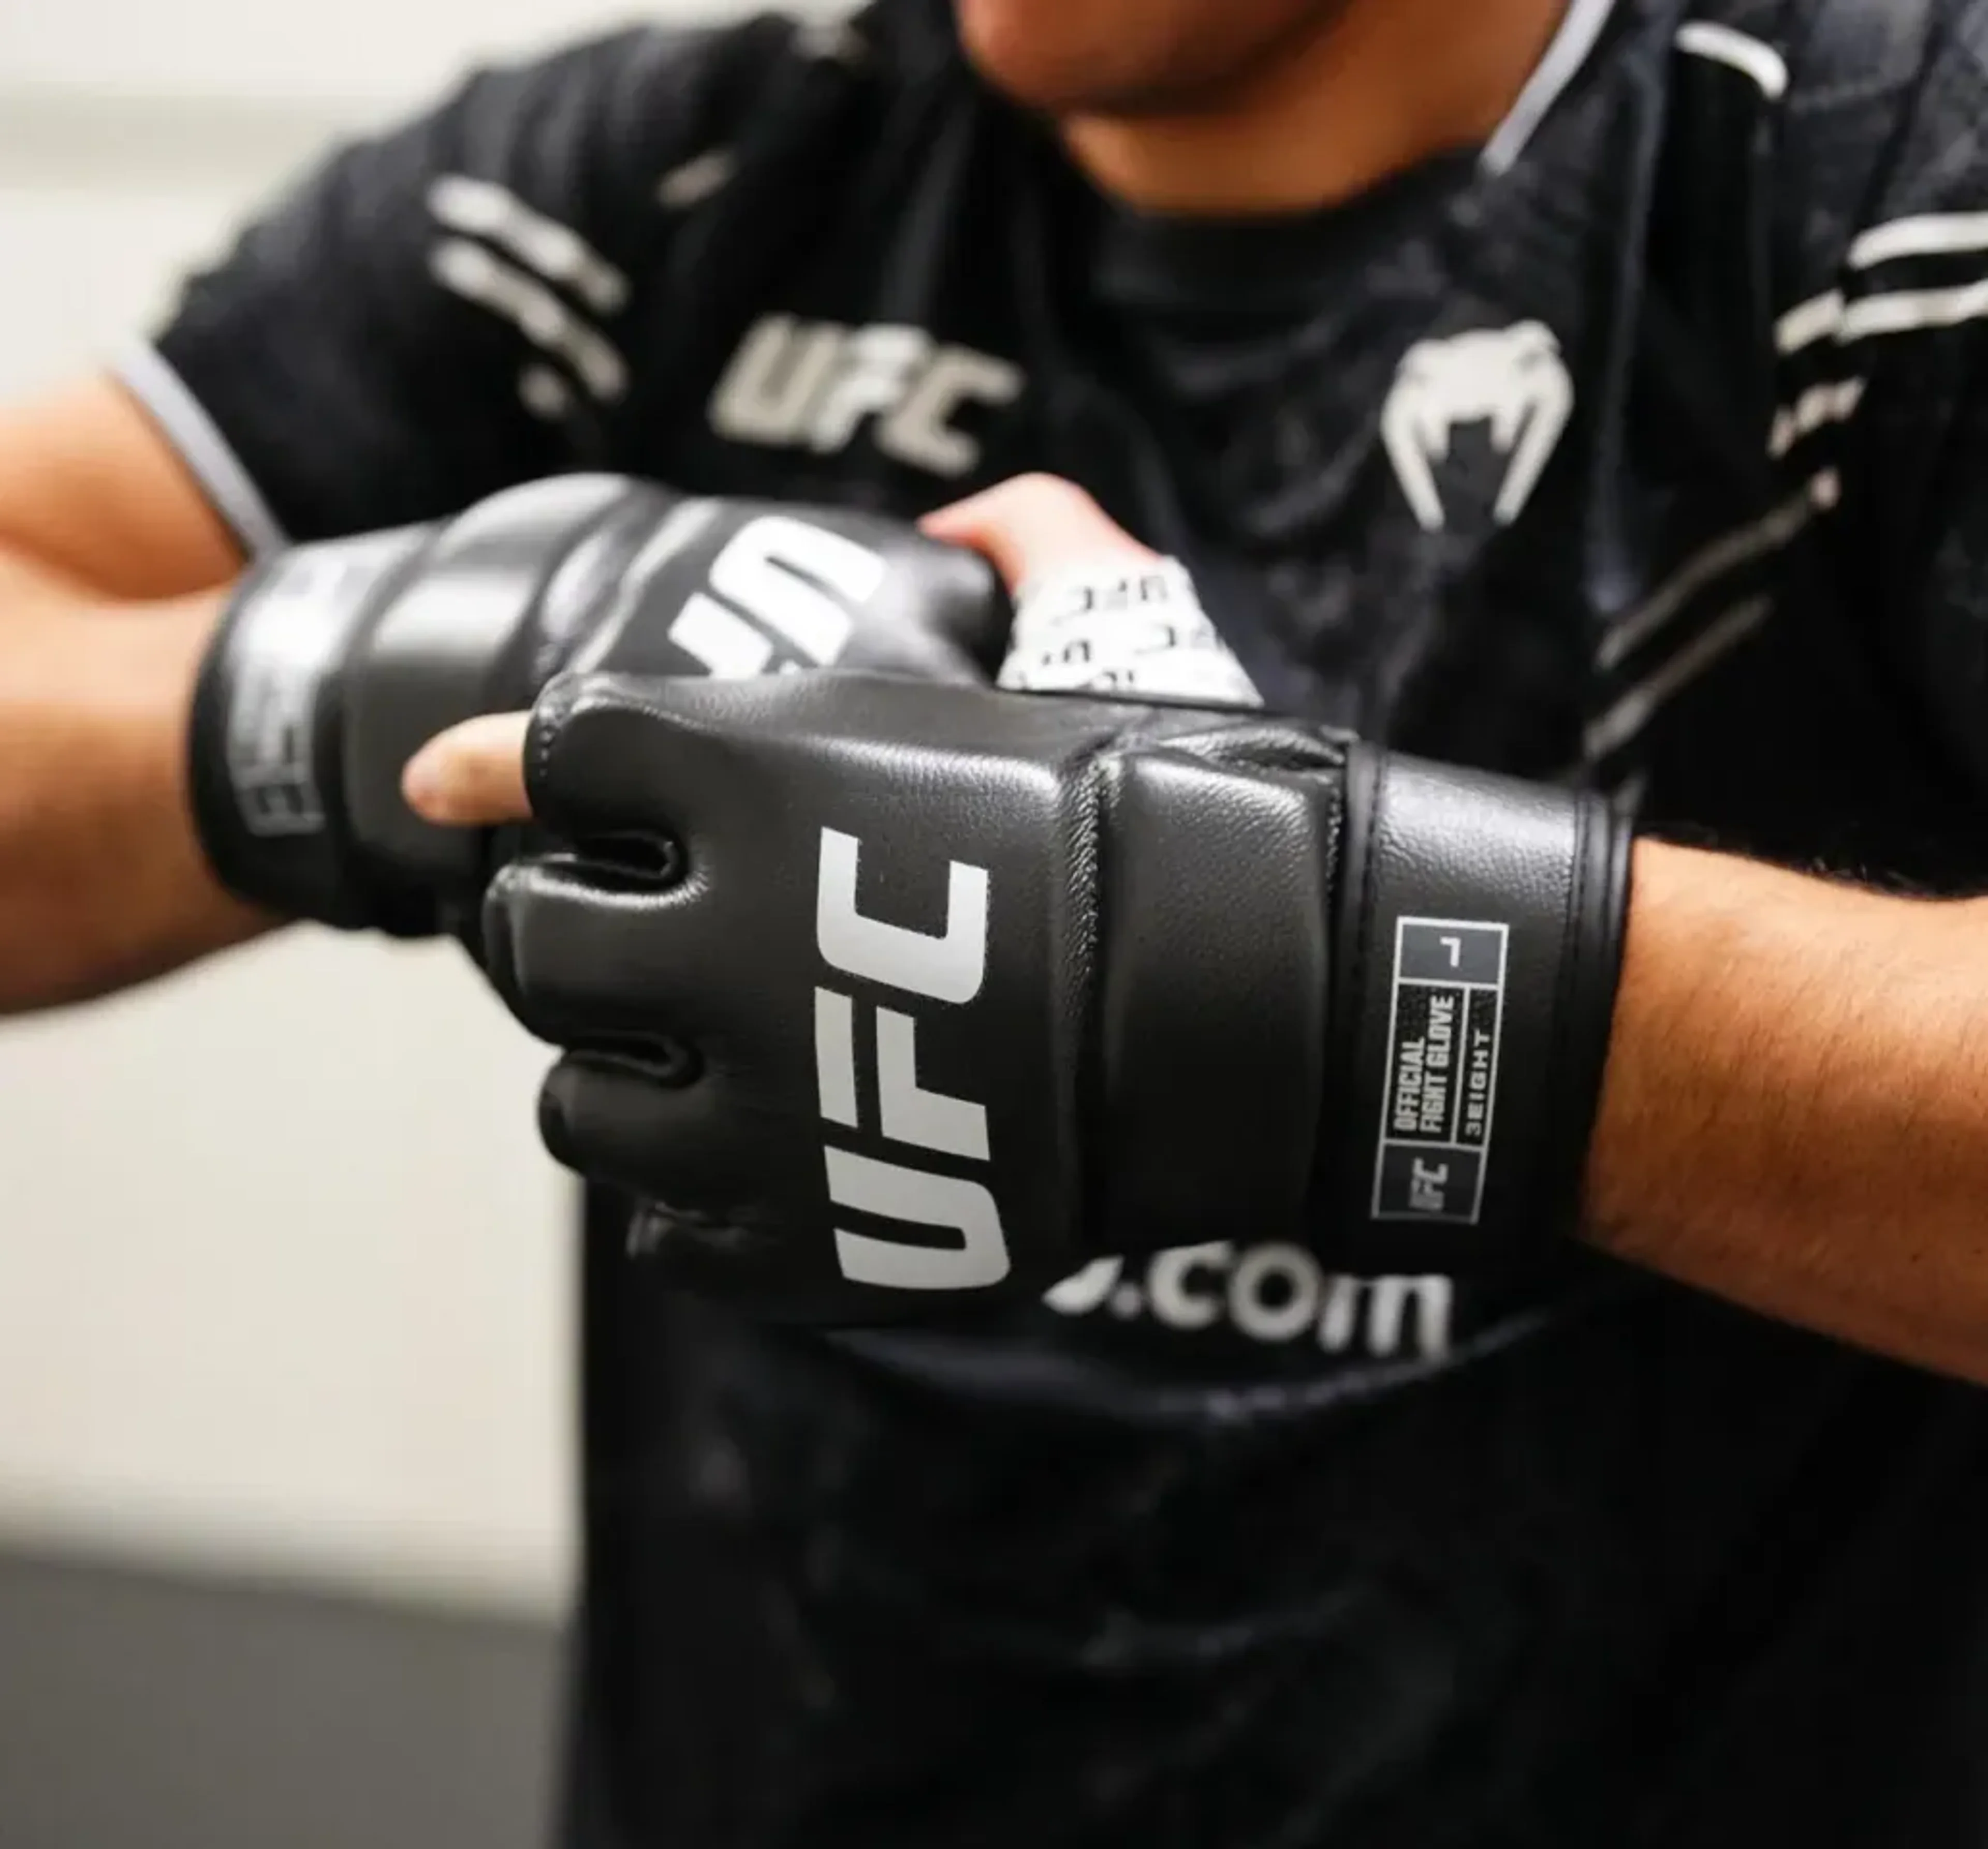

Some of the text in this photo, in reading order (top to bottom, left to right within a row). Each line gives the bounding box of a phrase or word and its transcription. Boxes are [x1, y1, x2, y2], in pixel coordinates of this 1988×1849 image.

[707, 311, 1024, 477] UFC
[814, 826, 1011, 1290] UFC
[1393, 1037, 1425, 1132] OFFICIAL
[1419, 994, 1455, 1133] FIGHT GLOVE
[1465, 1028, 1490, 1136] 3EIGHT
